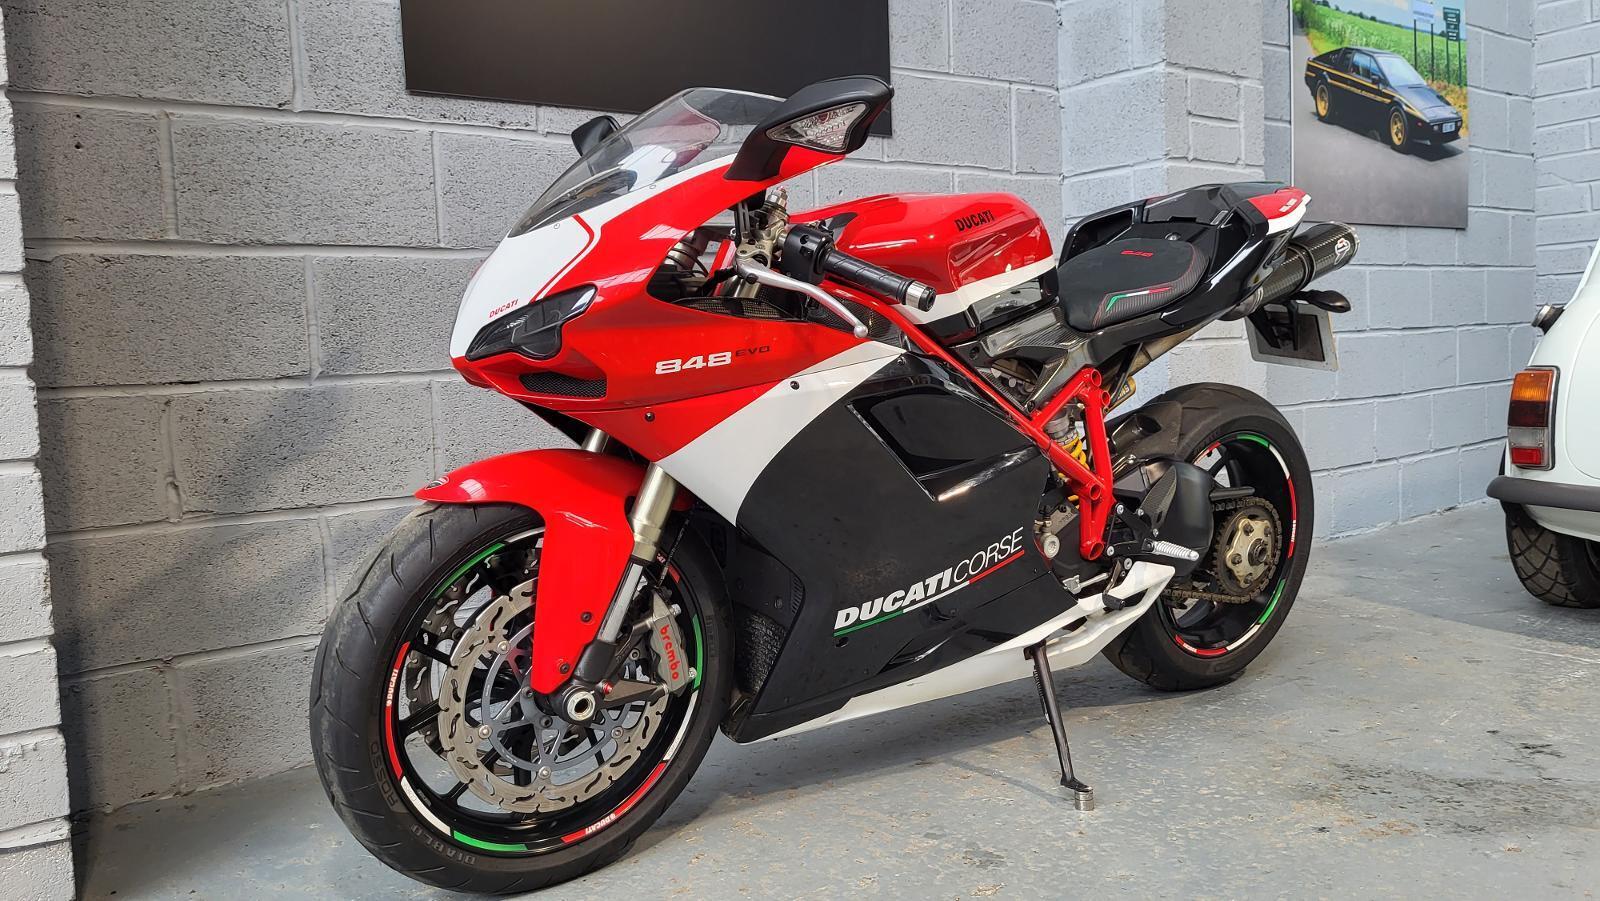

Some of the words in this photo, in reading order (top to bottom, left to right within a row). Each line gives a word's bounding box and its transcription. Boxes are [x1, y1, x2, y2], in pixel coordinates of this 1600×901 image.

[954, 209, 995, 232] DUCATI
[489, 298, 518, 318] DUCATI
[655, 351, 732, 375] 848
[735, 345, 770, 357] EVO
[834, 567, 953, 630] DUCATI
[953, 526, 1024, 583] CORSE
[660, 624, 680, 680] brembo
[370, 741, 396, 807] ROSSO
[411, 823, 476, 865] DIABLO
